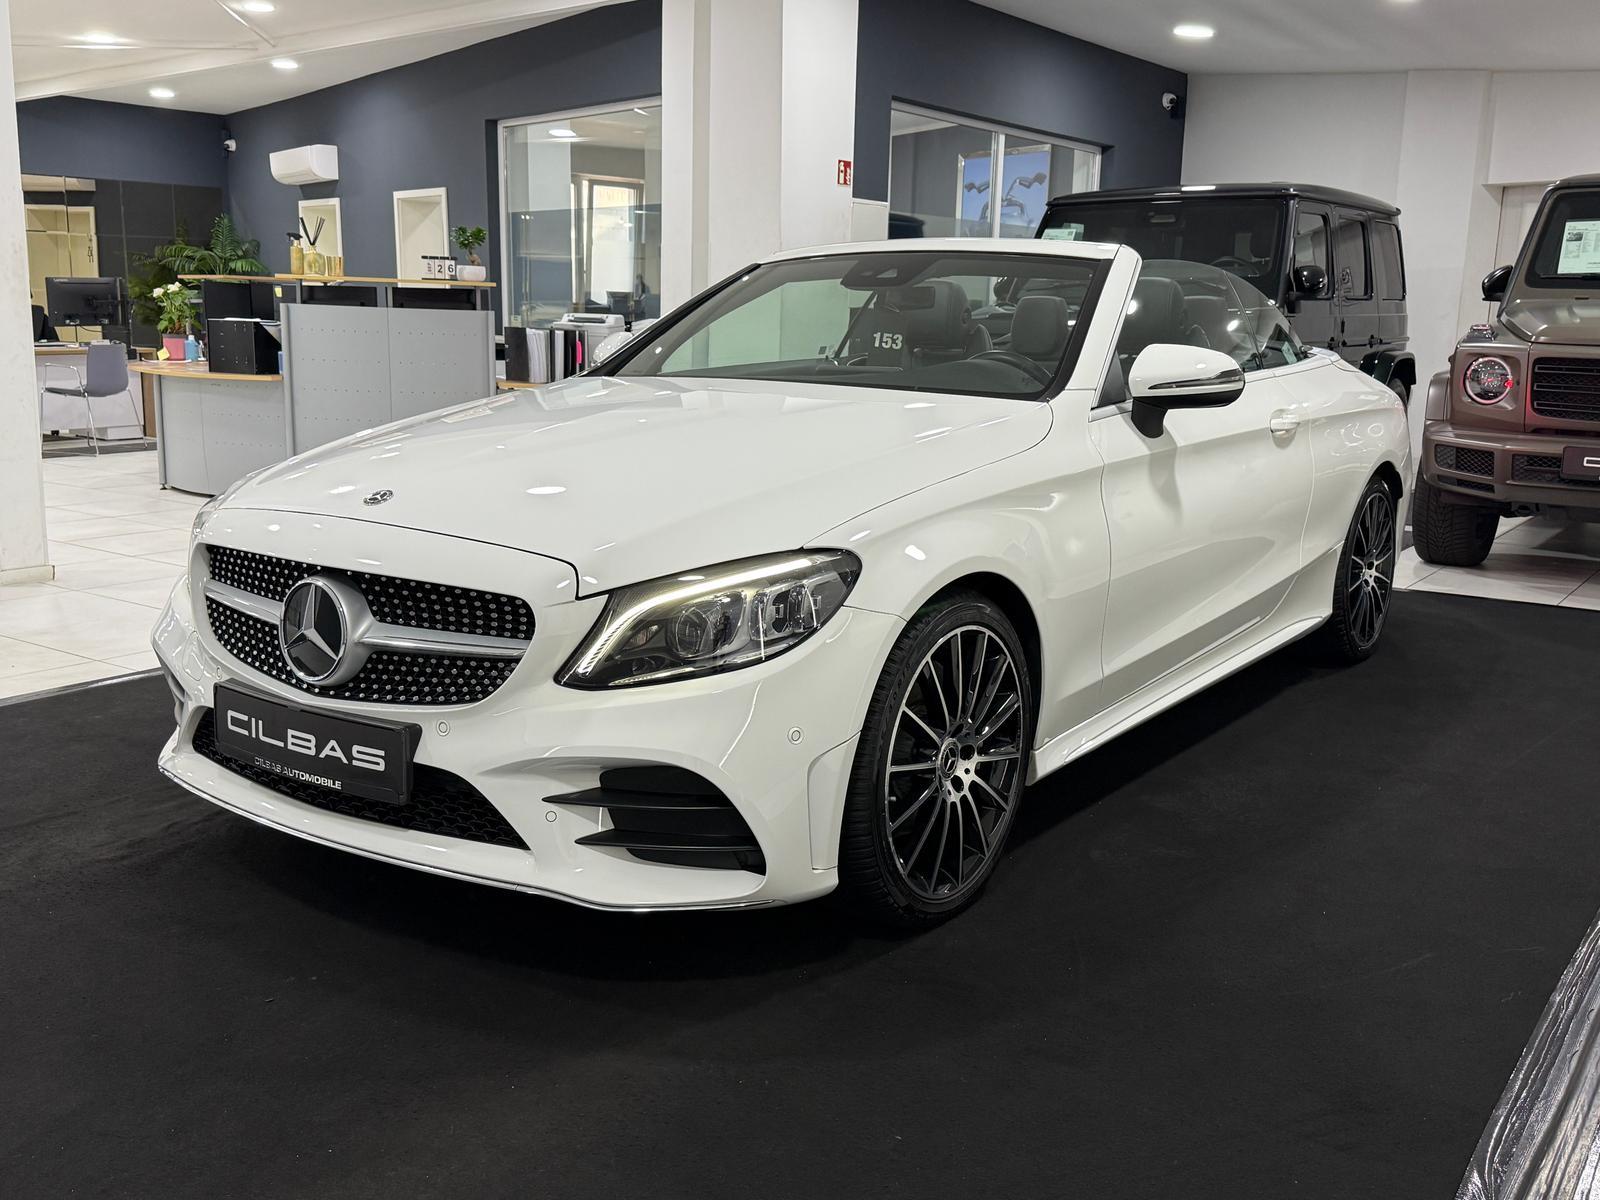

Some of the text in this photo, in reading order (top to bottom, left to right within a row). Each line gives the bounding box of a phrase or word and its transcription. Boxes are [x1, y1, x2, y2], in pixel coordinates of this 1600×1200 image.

[873, 332, 903, 350] 153
[227, 709, 386, 772] CILBAS
[254, 757, 342, 790] CILBAS AUTOMOBILE
